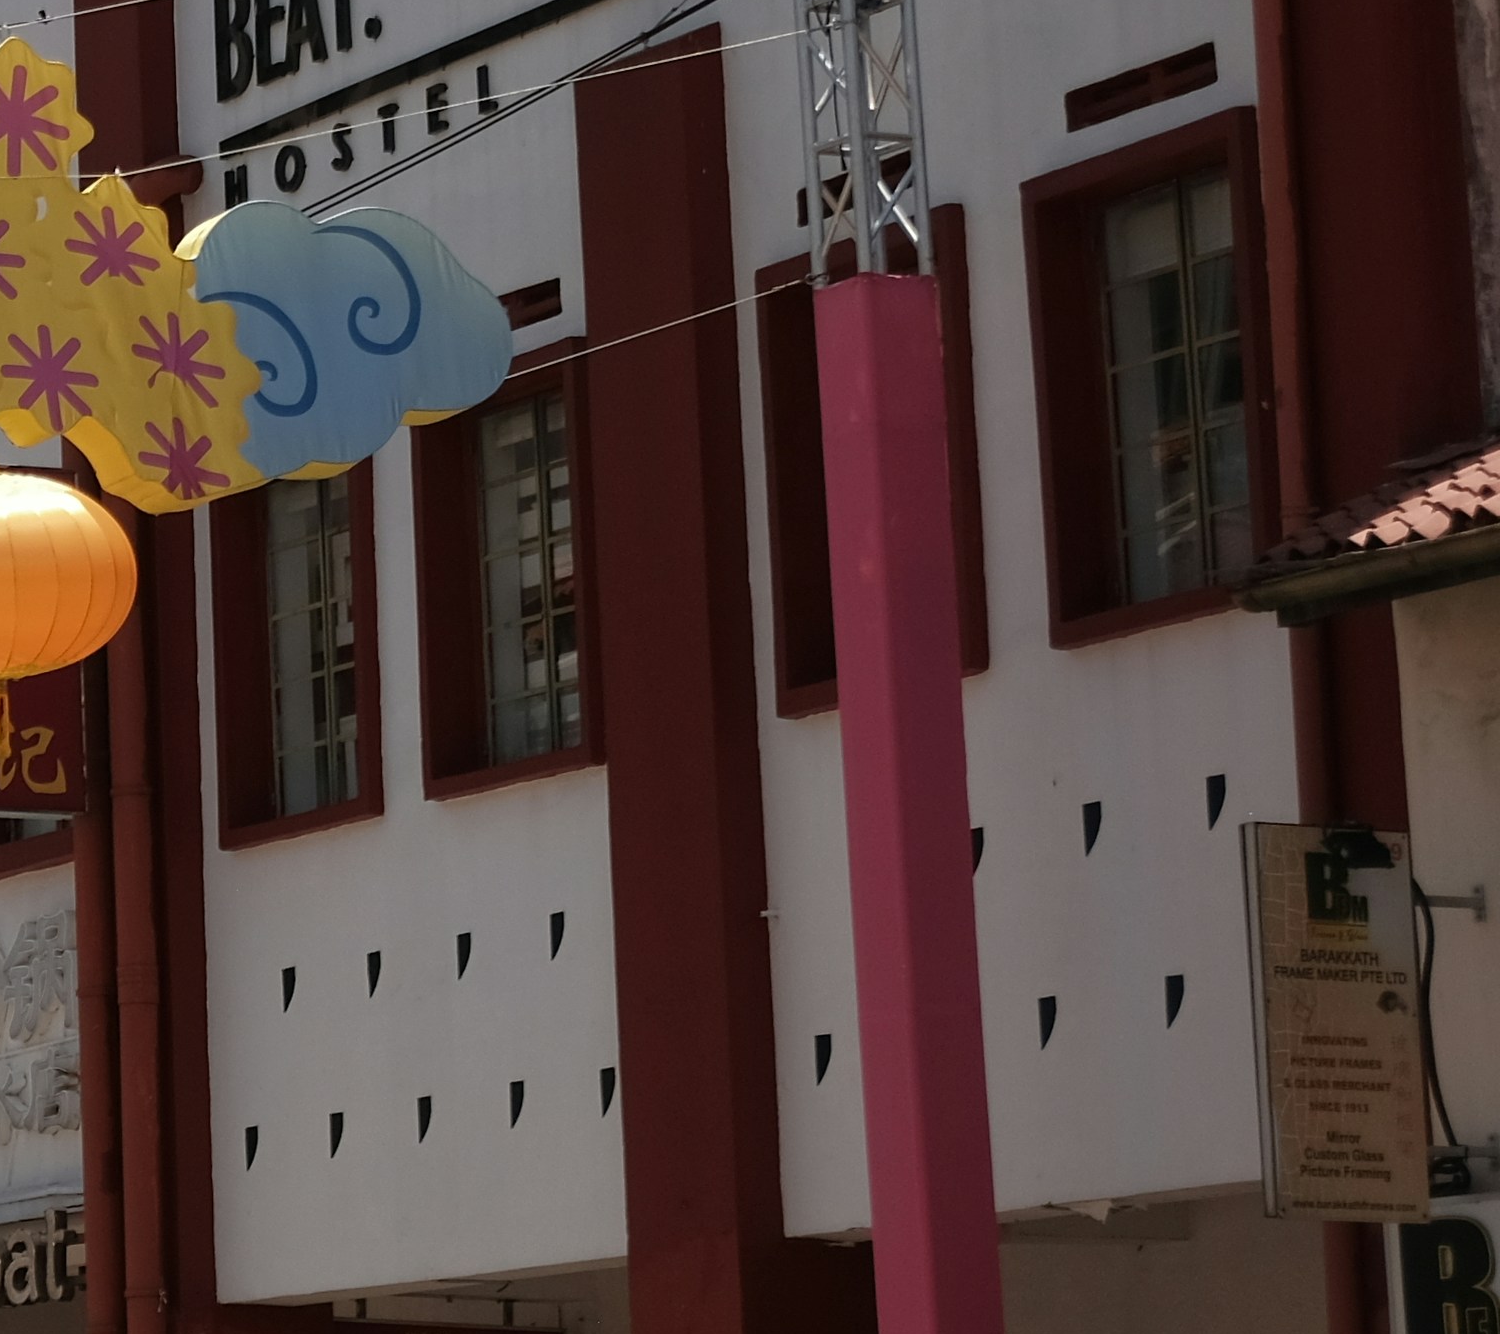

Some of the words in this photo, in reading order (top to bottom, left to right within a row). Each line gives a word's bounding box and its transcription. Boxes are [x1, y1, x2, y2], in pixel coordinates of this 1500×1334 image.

[223, 64, 500, 211] HOSTEL
[1301, 948, 1380, 966] BARAKKATH
[1273, 965, 1316, 980] FRAME
[1316, 968, 1360, 983] MAKER
[1361, 970, 1384, 984] PTE
[1386, 971, 1408, 985] LTD
[1326, 1130, 1362, 1144] Mirror
[1304, 1146, 1349, 1160] Custom
[1352, 1148, 1385, 1162] Glass
[1300, 1164, 1341, 1178] Picture
[1343, 1166, 1392, 1182] Framing
